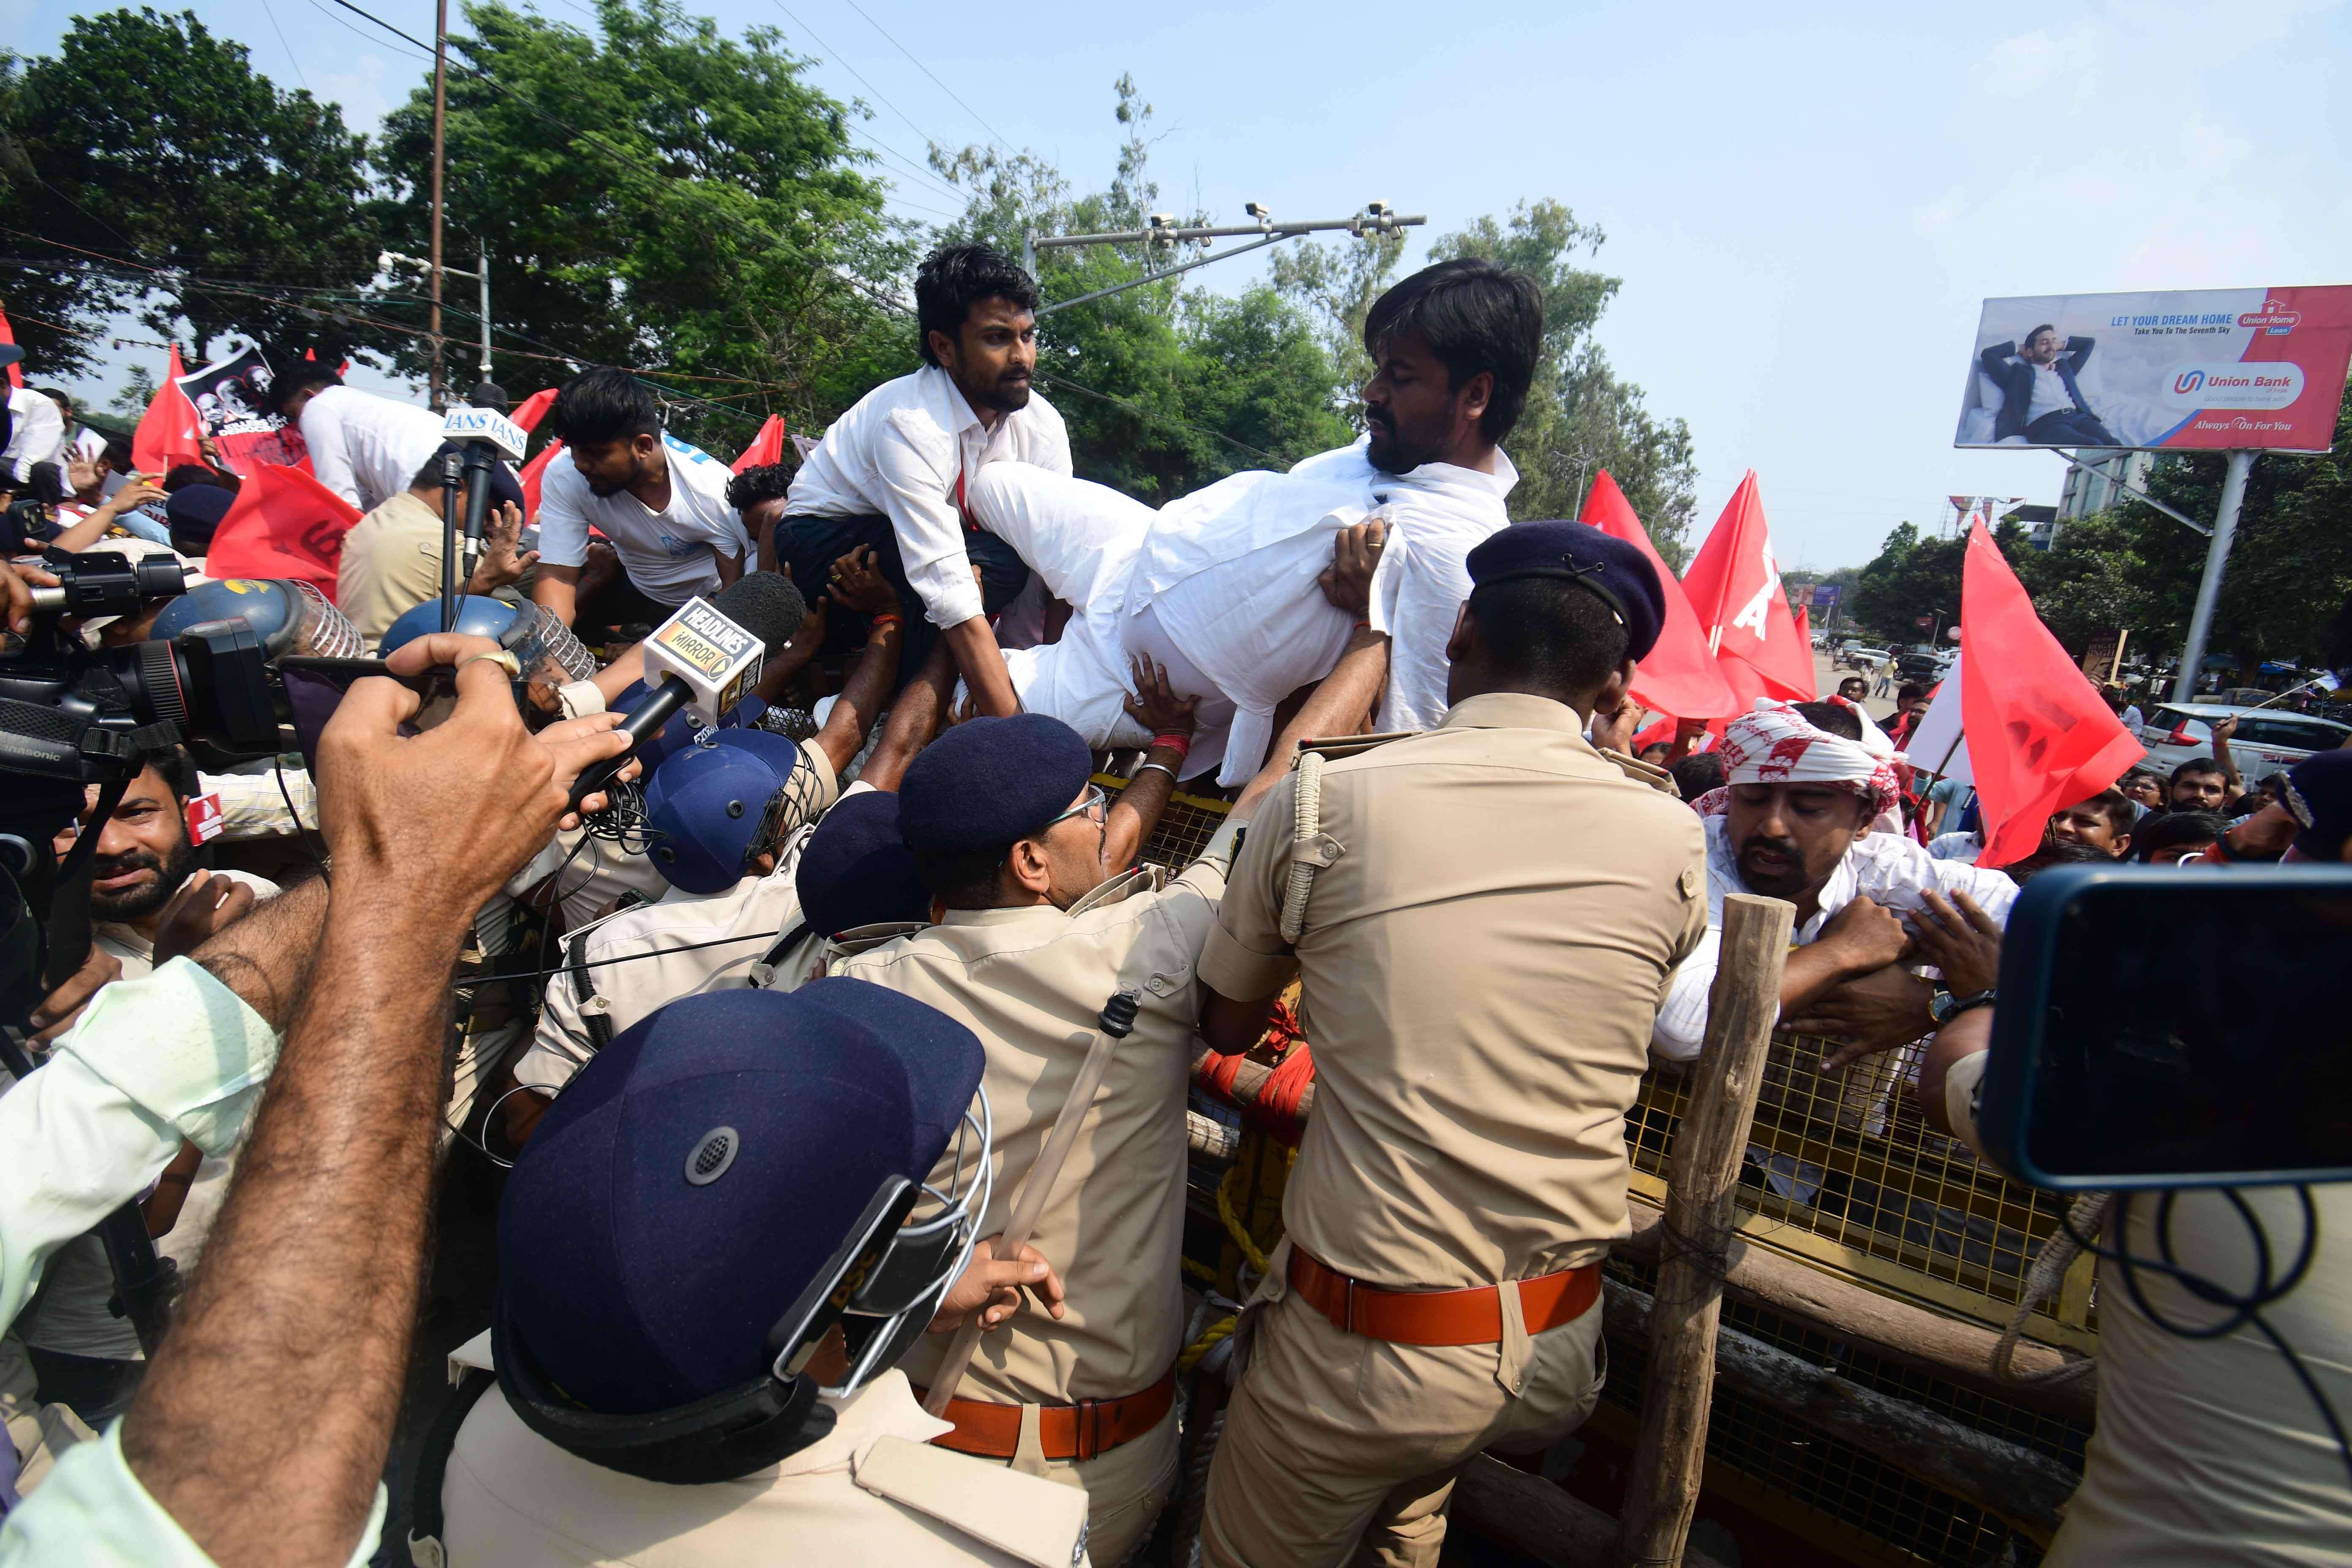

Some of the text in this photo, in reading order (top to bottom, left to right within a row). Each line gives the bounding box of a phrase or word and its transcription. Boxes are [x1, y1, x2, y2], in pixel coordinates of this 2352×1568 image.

[2112, 314, 2233, 327] LET YOUR DREAM HOME
[2243, 316, 2295, 324] Union Home
[2218, 326, 2230, 335] Sky
[2208, 376, 2292, 387] Union Bank
[218, 416, 290, 436] DEMOCRACY
[223, 418, 270, 431] KILLERS
[445, 412, 488, 429] IANS
[2194, 421, 2292, 431] Always On For You
[491, 418, 526, 450] IANS
[683, 607, 749, 655] HEADLINES
[672, 631, 716, 665] MIRROR
[0, 744, 61, 761] anasonic
[829, 1246, 879, 1310] DSC
